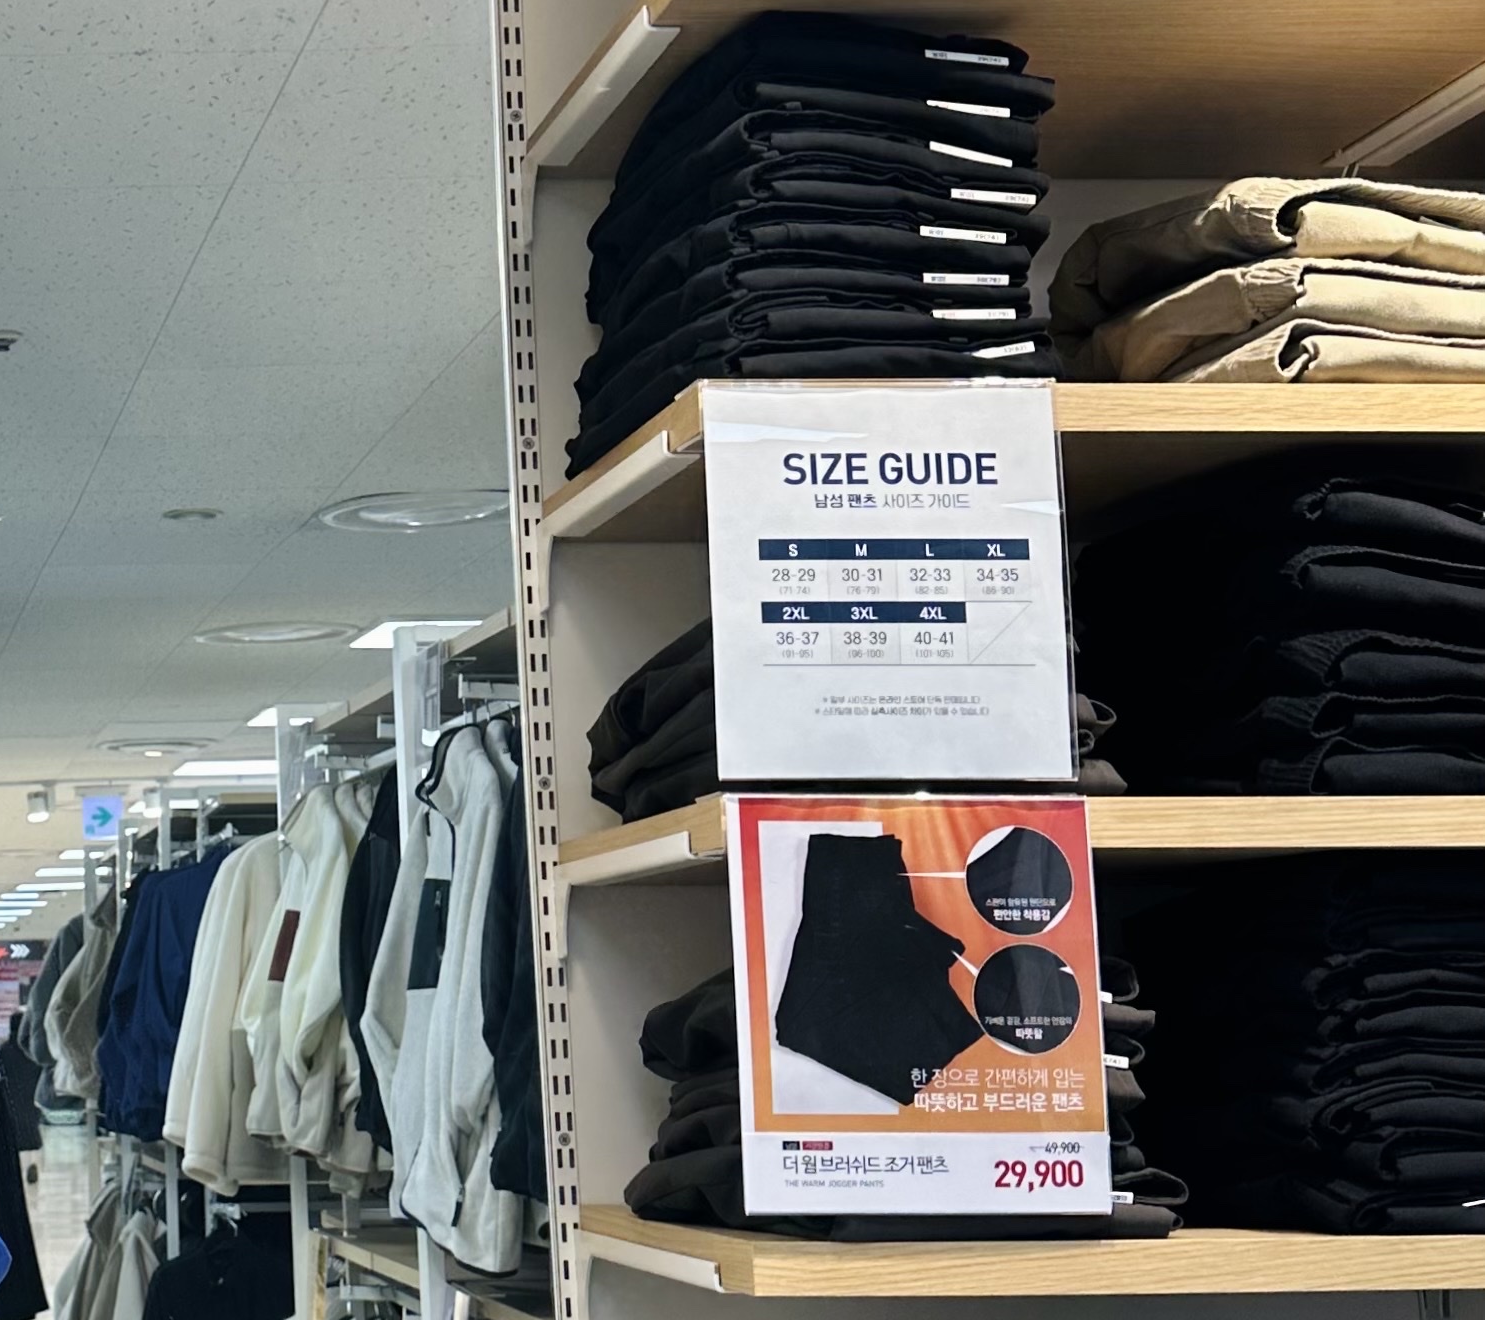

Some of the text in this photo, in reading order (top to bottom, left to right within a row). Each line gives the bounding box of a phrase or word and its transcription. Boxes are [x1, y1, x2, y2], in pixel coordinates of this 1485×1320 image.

[782, 452, 999, 485] SIZE GUIDE
[814, 493, 971, 510] 남성 팬츠 사이즈 가이드
[787, 543, 1006, 558] S M L XL
[771, 568, 1019, 582] 28-29 30-31 32-33 34-35
[782, 606, 947, 621] 2XL 3XL 4XL
[775, 631, 954, 645] 36-37 38-39 40-41
[910, 1068, 1086, 1089] 한 장으로 간편하게 입는
[915, 1092, 1085, 1113] 따뜻하고 부드러운 팬츠
[1044, 1141, 1082, 1156] 49,900
[782, 1156, 800, 1174] 더
[801, 1155, 817, 1174] 웜
[884, 1156, 916, 1174] 조거
[916, 1156, 949, 1174] 팬츠
[784, 1179, 885, 1188] THE WARM JOGGER PANTS
[993, 1159, 1084, 1193] 29,900
